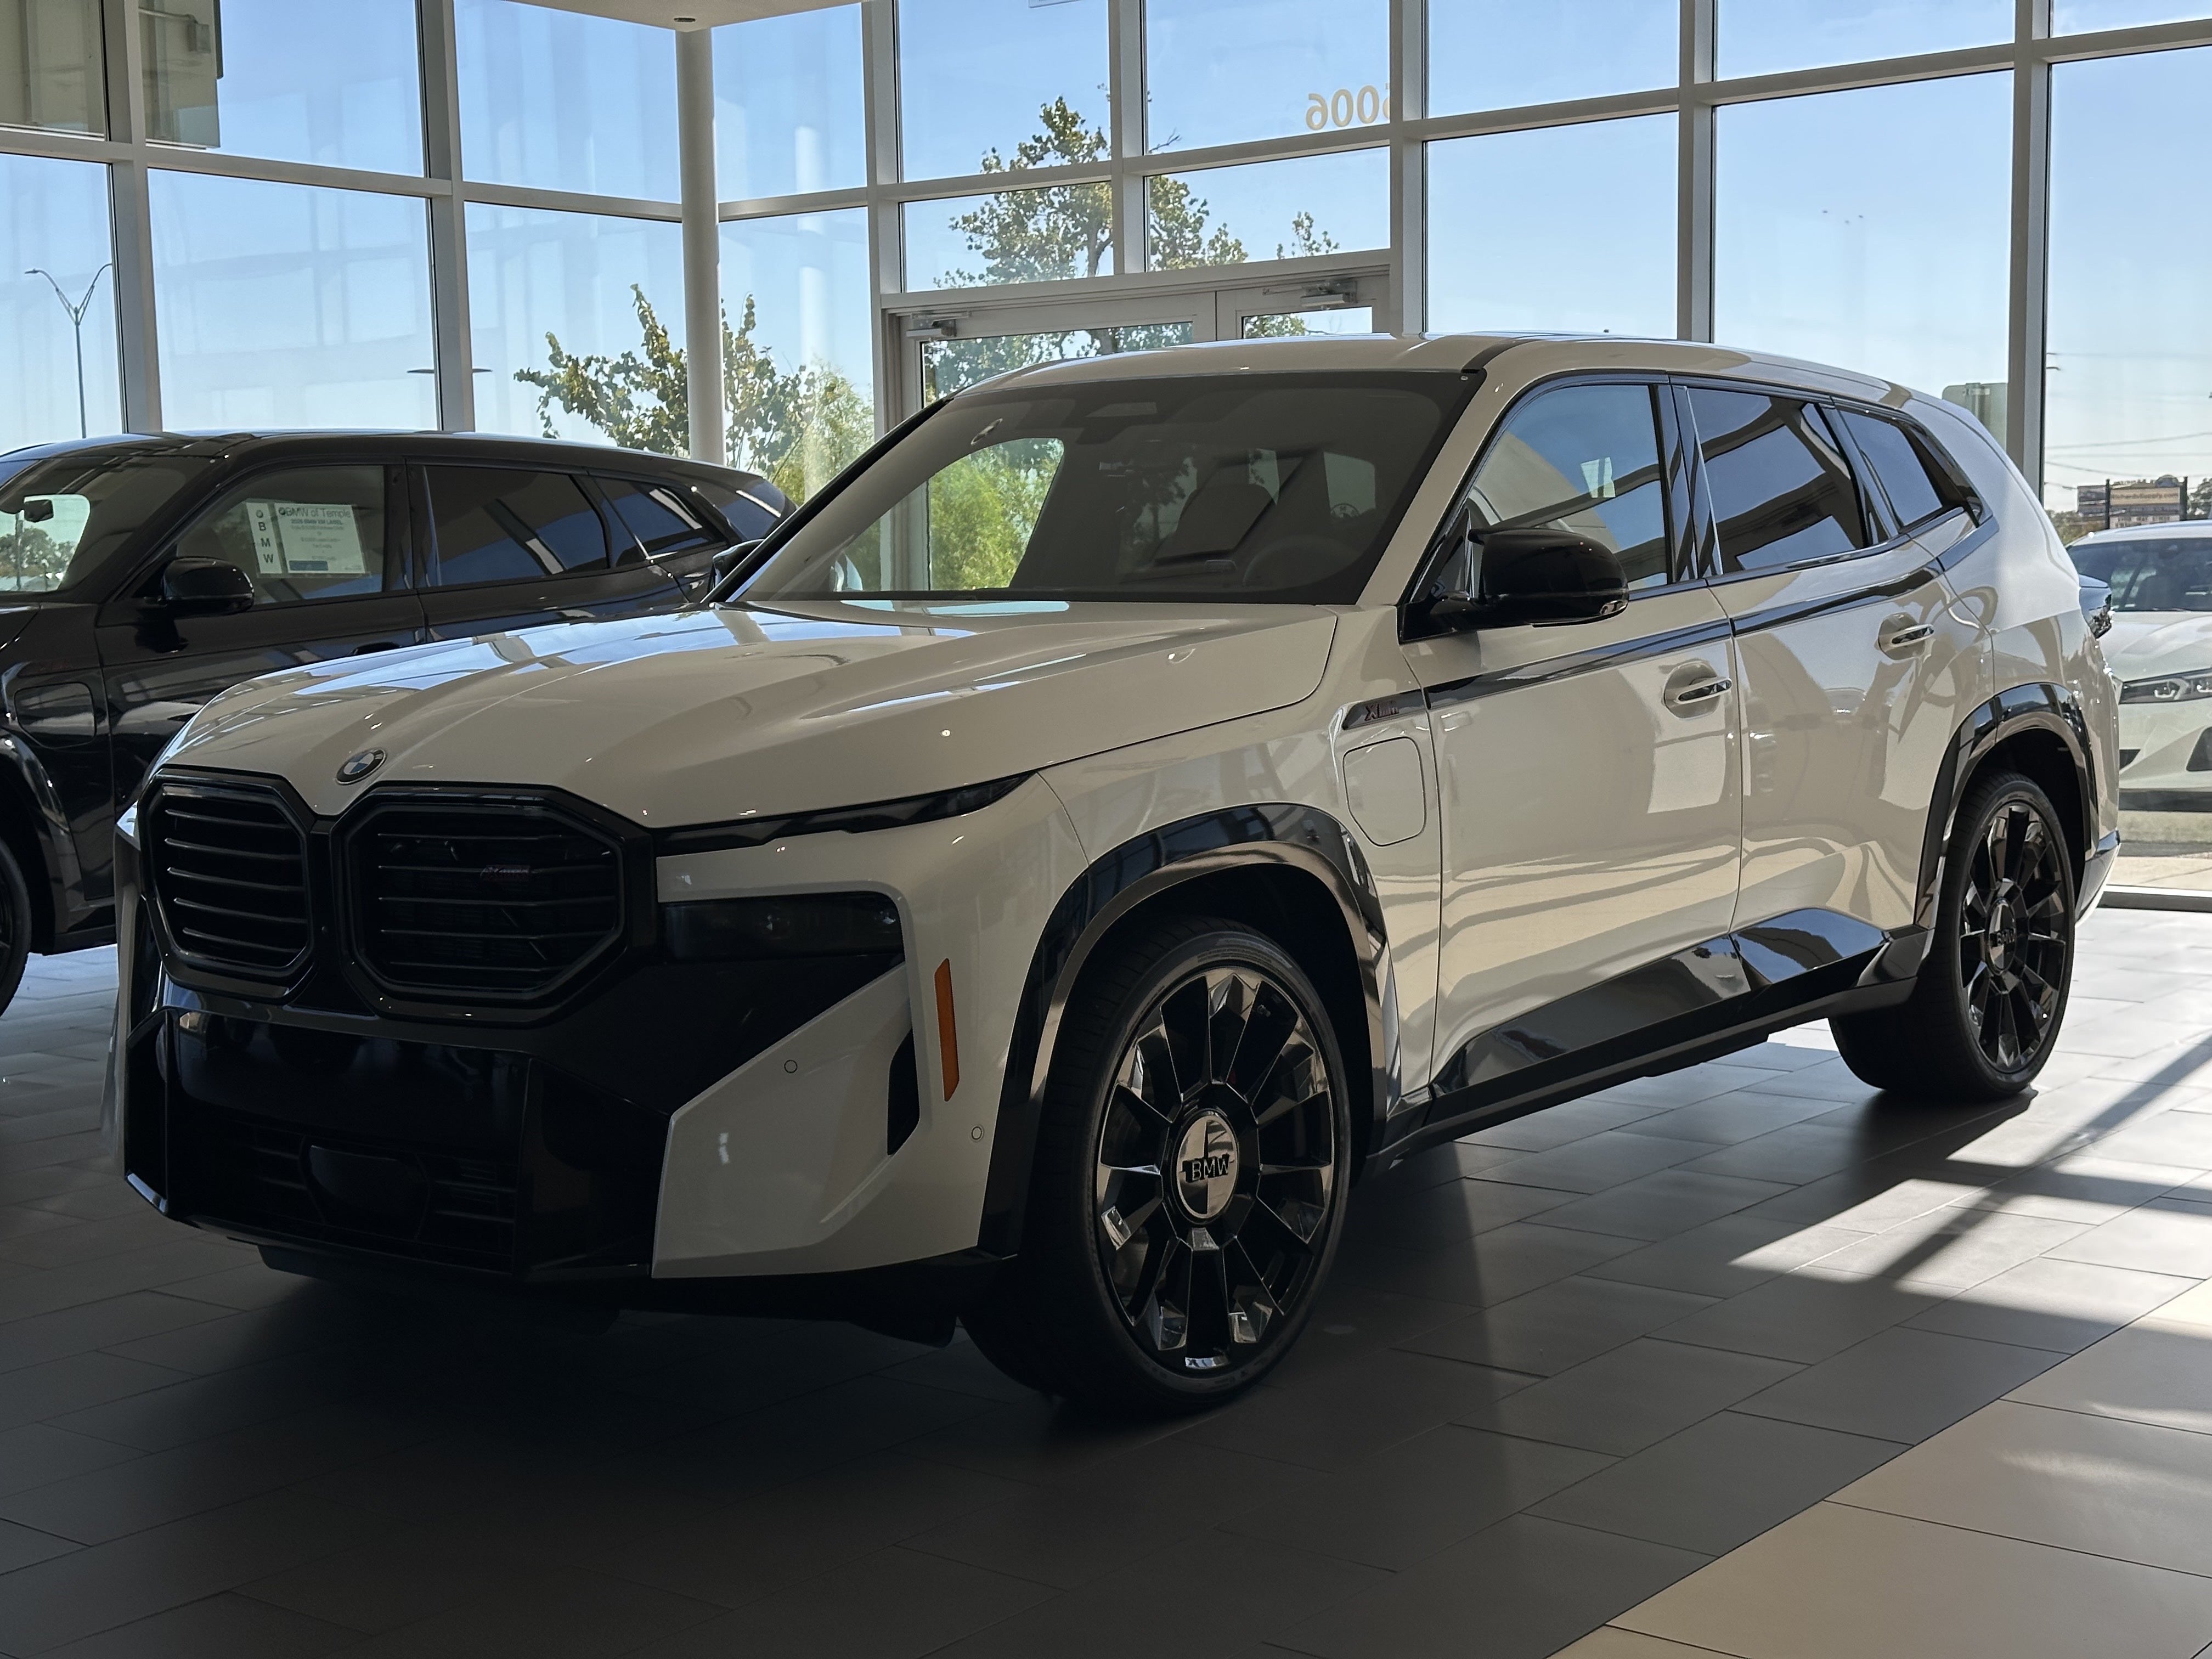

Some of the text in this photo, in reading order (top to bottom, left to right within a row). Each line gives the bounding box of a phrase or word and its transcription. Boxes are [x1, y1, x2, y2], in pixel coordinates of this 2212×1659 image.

[286, 507, 352, 520] BMW of Temple
[1996, 929, 2015, 946] BMW
[1190, 1155, 1230, 1181] BMW
